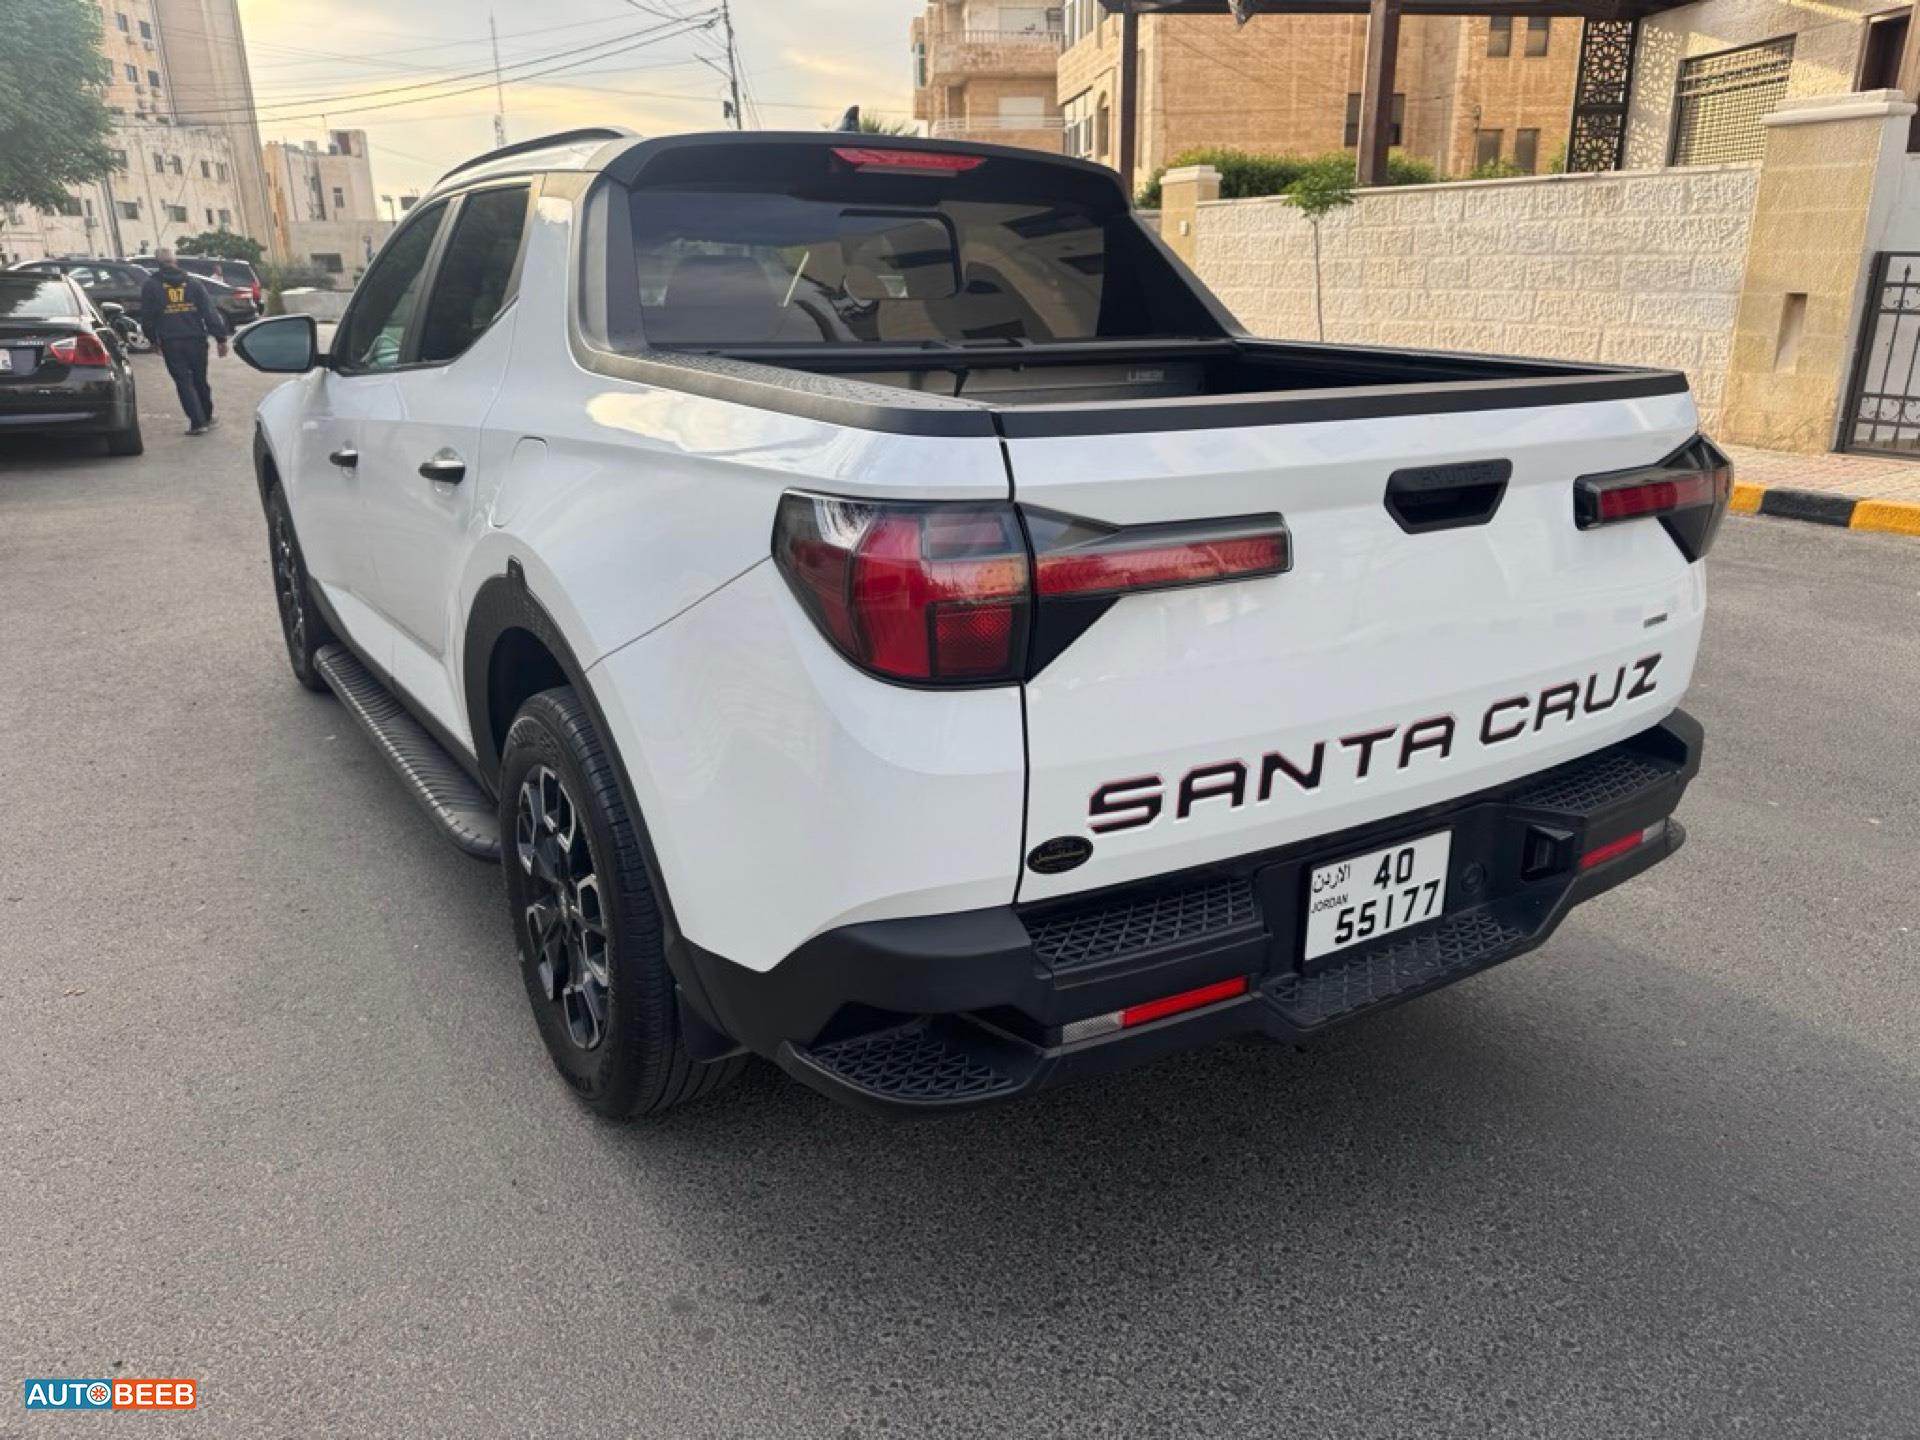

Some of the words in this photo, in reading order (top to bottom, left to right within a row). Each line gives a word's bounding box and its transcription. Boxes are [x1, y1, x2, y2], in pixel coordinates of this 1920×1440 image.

[1087, 712, 1457, 834] SANTA
[1479, 652, 1662, 745] CRUZ
[1373, 847, 1415, 889] 40
[1311, 893, 1349, 913] JORDAN
[1335, 878, 1441, 944] 55177
